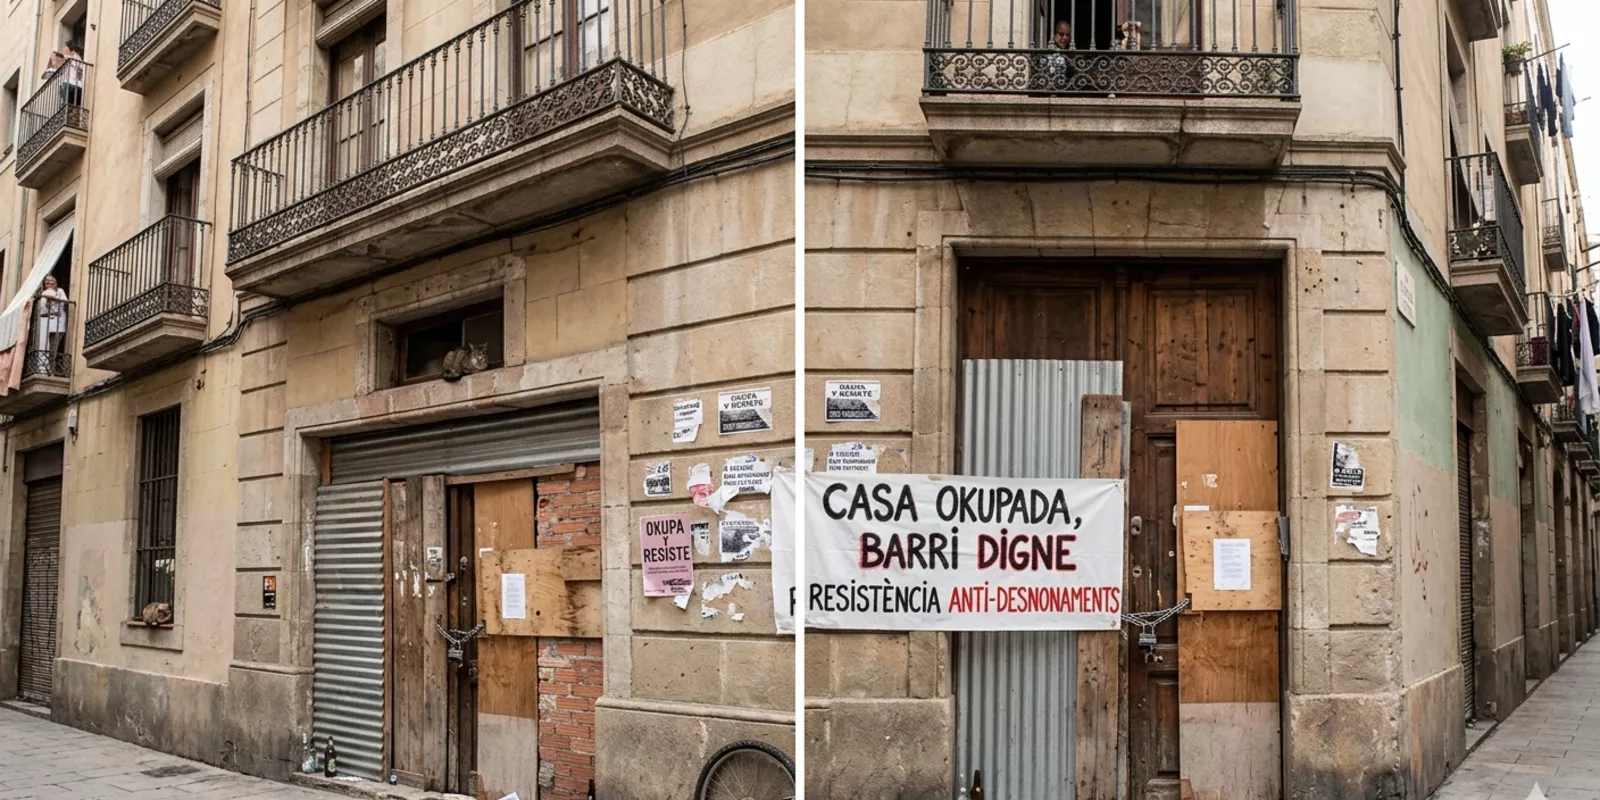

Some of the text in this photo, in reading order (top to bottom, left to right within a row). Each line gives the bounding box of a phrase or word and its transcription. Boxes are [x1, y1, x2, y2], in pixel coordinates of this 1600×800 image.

[823, 483, 1082, 530] CASA OKUPADA,
[646, 519, 685, 536] OKUPA
[643, 546, 691, 563] RESISTE
[662, 536, 669, 547] Y
[859, 526, 1078, 571] BARRI DIGNE
[810, 578, 942, 614] RESISTÈNCIA
[948, 581, 1121, 614] ANTI-DESNONAMENTS
